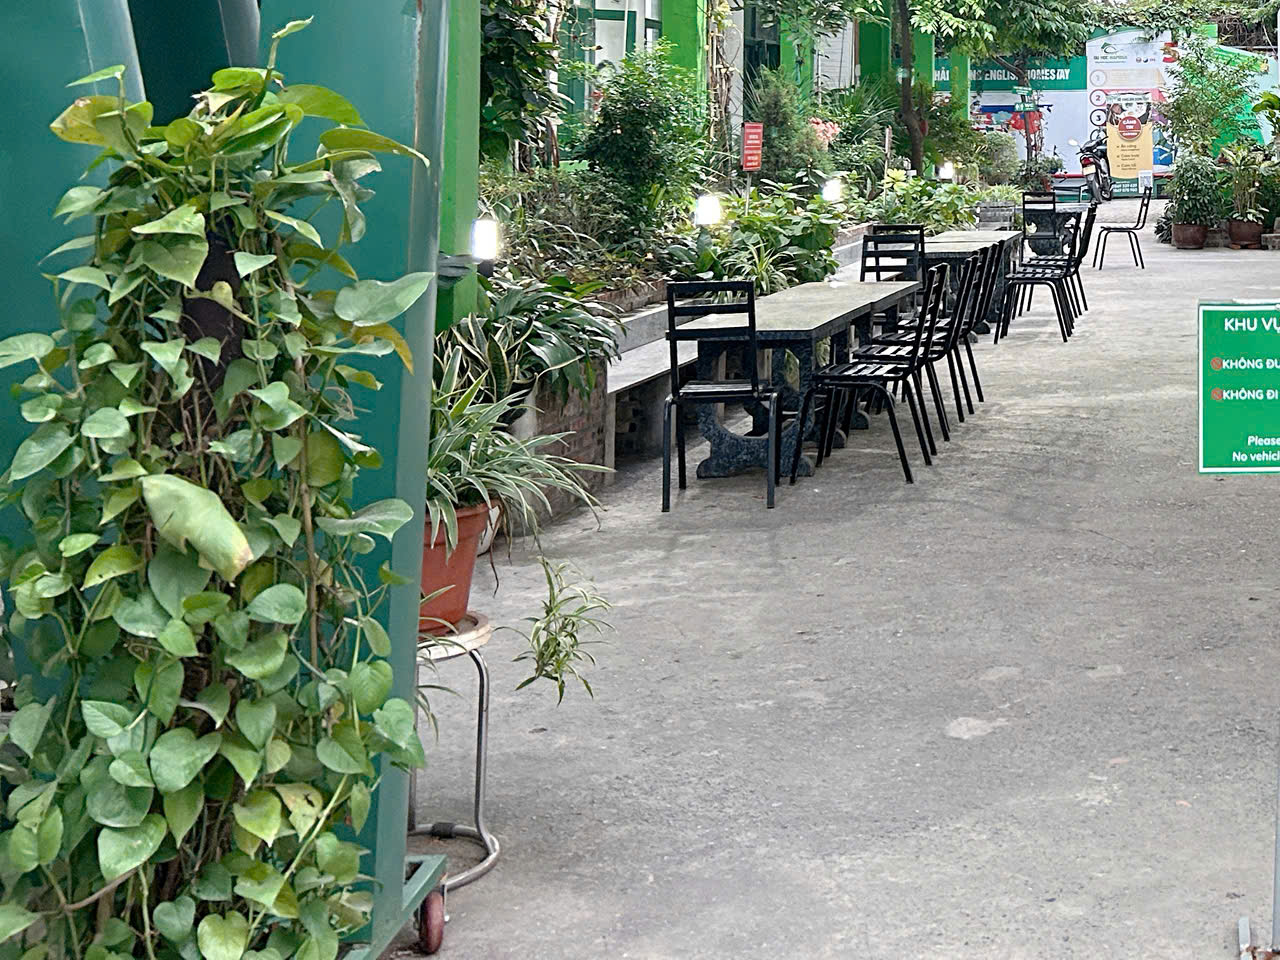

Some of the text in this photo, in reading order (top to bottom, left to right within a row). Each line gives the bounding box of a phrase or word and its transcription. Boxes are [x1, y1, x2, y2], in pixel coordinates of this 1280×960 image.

[985, 69, 1018, 81] ENGLIS
[1224, 317, 1258, 332] KHU
[1222, 357, 1264, 370] KHÔNG
[1222, 387, 1264, 401] KHÔNG
[1266, 389, 1279, 400] ĐI
[1232, 451, 1248, 462] No
